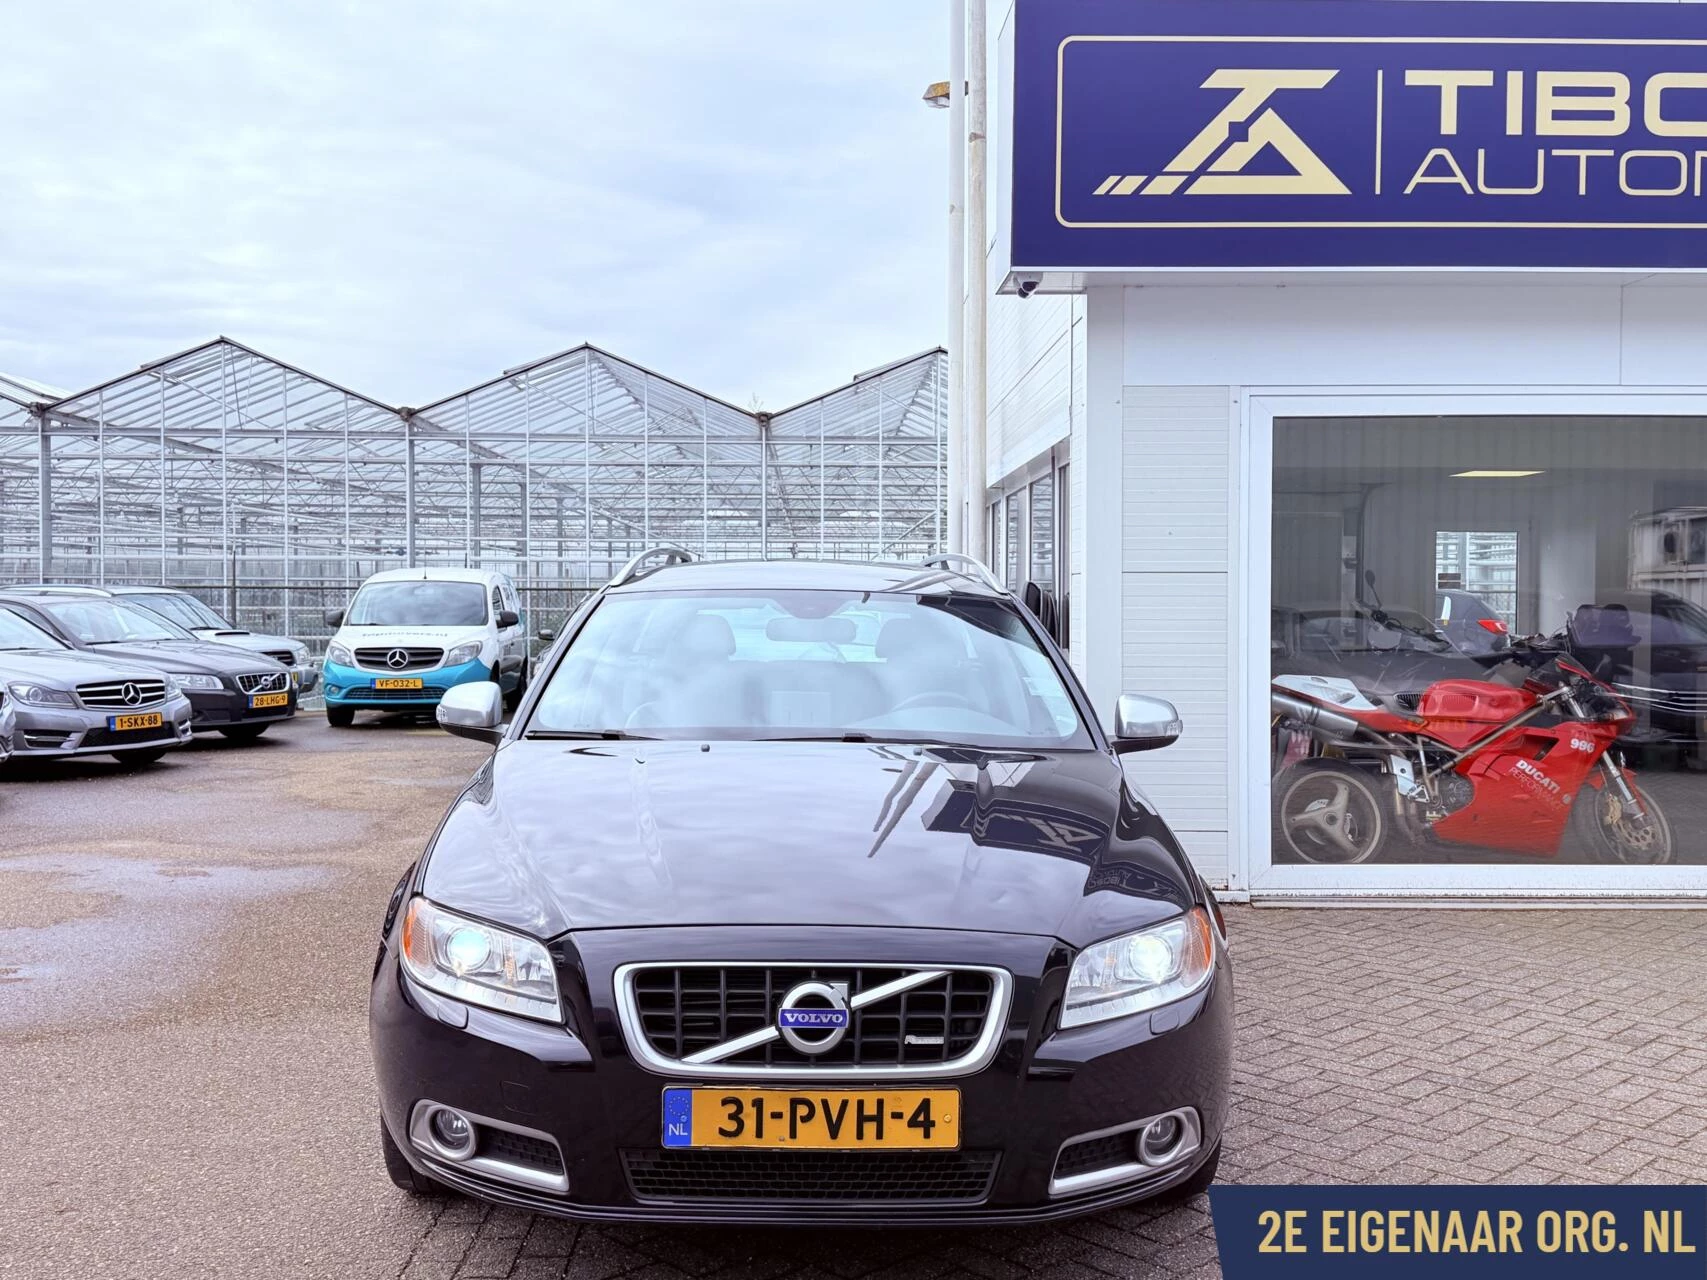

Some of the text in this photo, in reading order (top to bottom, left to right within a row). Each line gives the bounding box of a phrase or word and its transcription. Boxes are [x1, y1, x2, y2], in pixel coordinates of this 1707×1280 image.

[1403, 148, 1707, 197] AUTO
[378, 679, 419, 688] VF-032-L
[119, 714, 158, 729] 1-SKX-88
[1516, 759, 1561, 794] DUCATI
[784, 1013, 844, 1024] VOLVO
[718, 1097, 936, 1141] 31-PVH-4
[669, 1123, 688, 1137] NL
